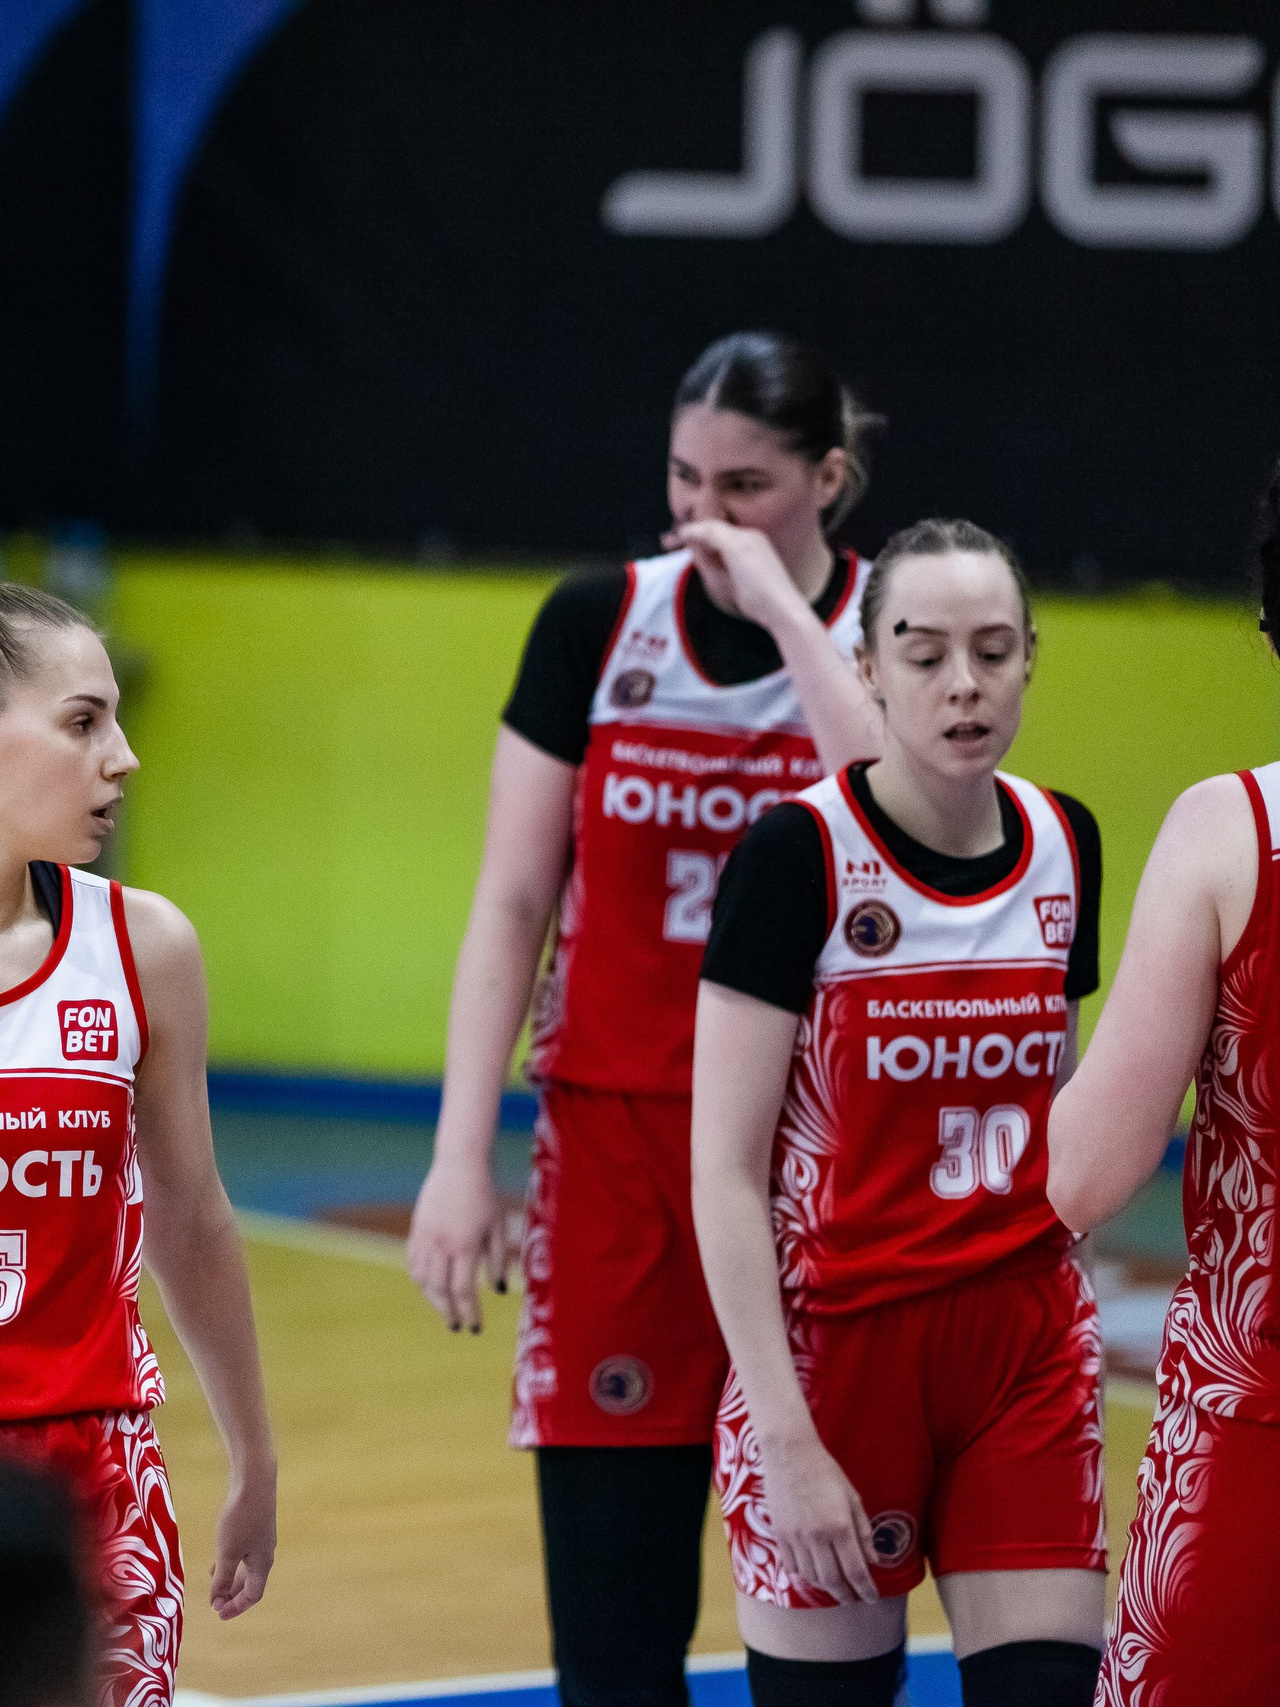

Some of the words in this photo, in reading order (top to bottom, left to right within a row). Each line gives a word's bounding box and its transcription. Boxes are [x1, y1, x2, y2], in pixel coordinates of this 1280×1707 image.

[601, 0, 1280, 250] JÖG
[603, 772, 788, 833] ЮНОС
[664, 850, 723, 943] 2
[63, 1005, 111, 1028] FON
[867, 993, 1040, 1019] БАСКЕТБОЛЬНЫЙ
[66, 1029, 115, 1053] BET
[58, 1110, 111, 1129] КЛУБ
[930, 1103, 1031, 1199] 30
